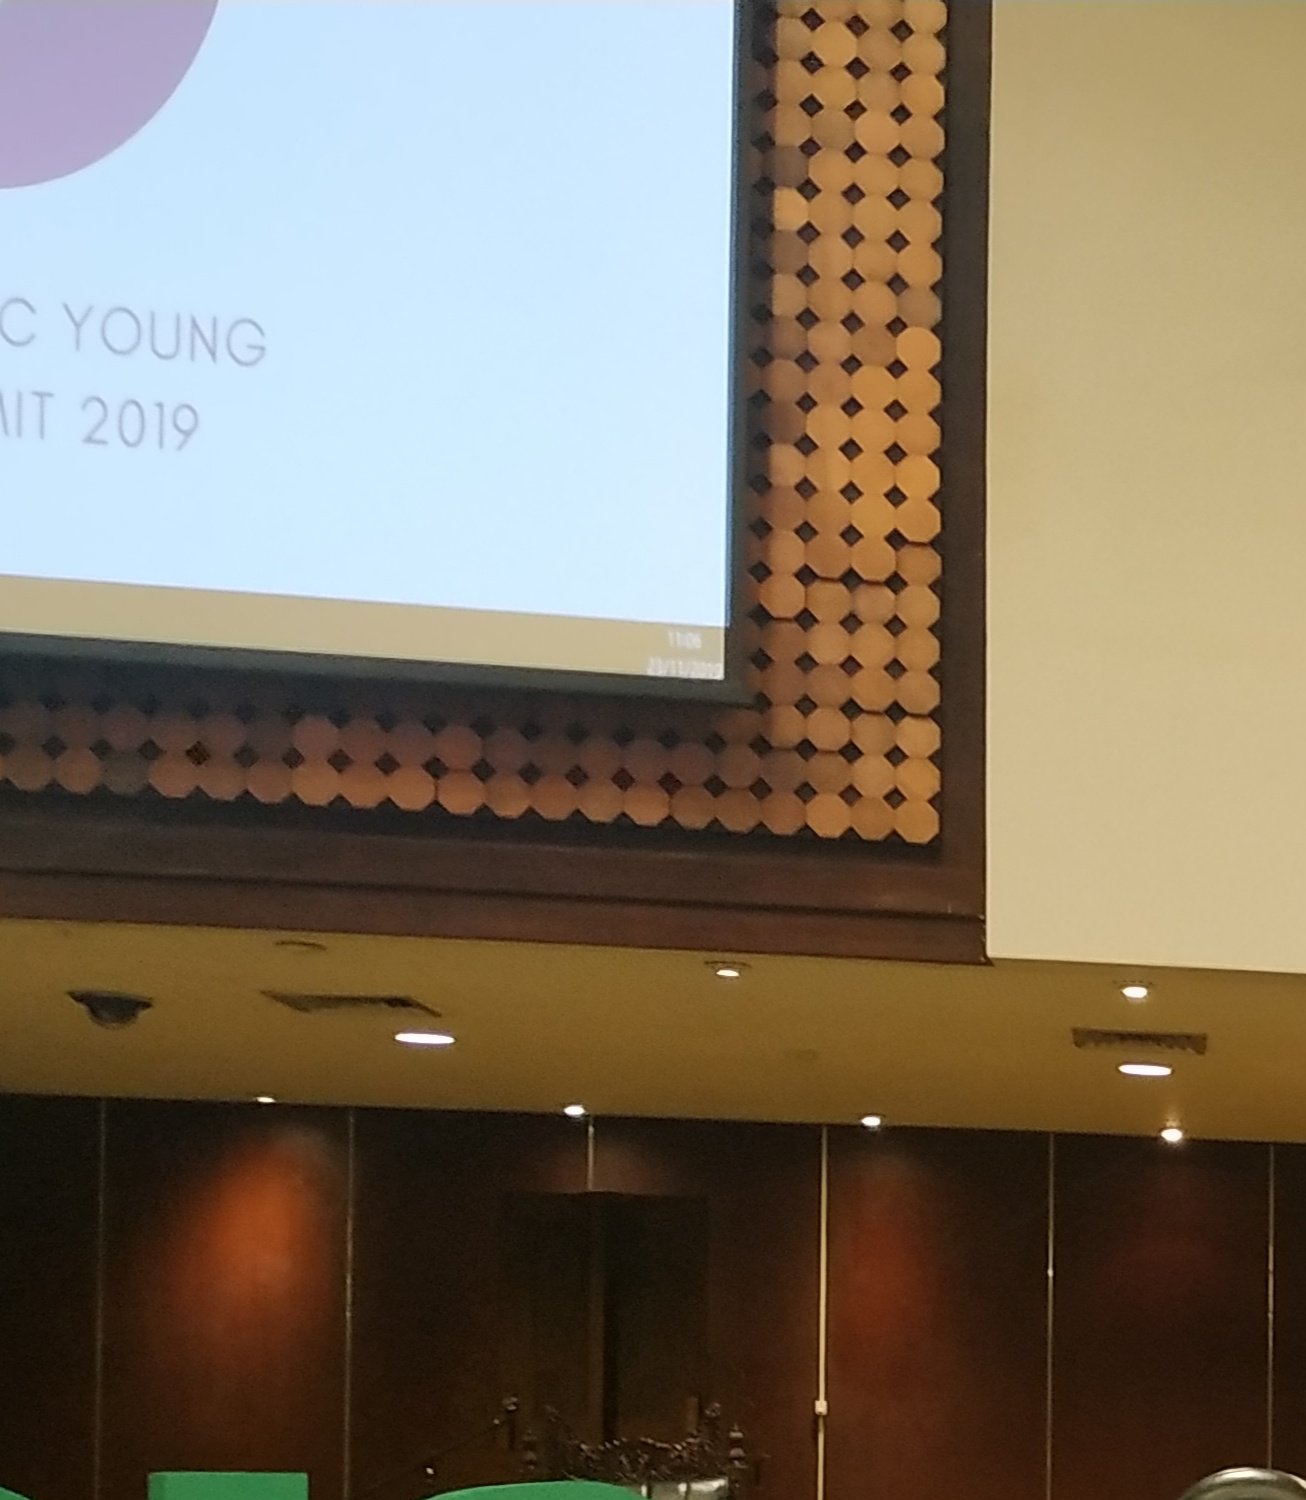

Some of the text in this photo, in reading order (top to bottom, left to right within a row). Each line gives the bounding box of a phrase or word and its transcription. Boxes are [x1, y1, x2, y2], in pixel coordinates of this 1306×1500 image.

[62, 302, 266, 367] YOUNG
[0, 388, 200, 451] IT 2019
